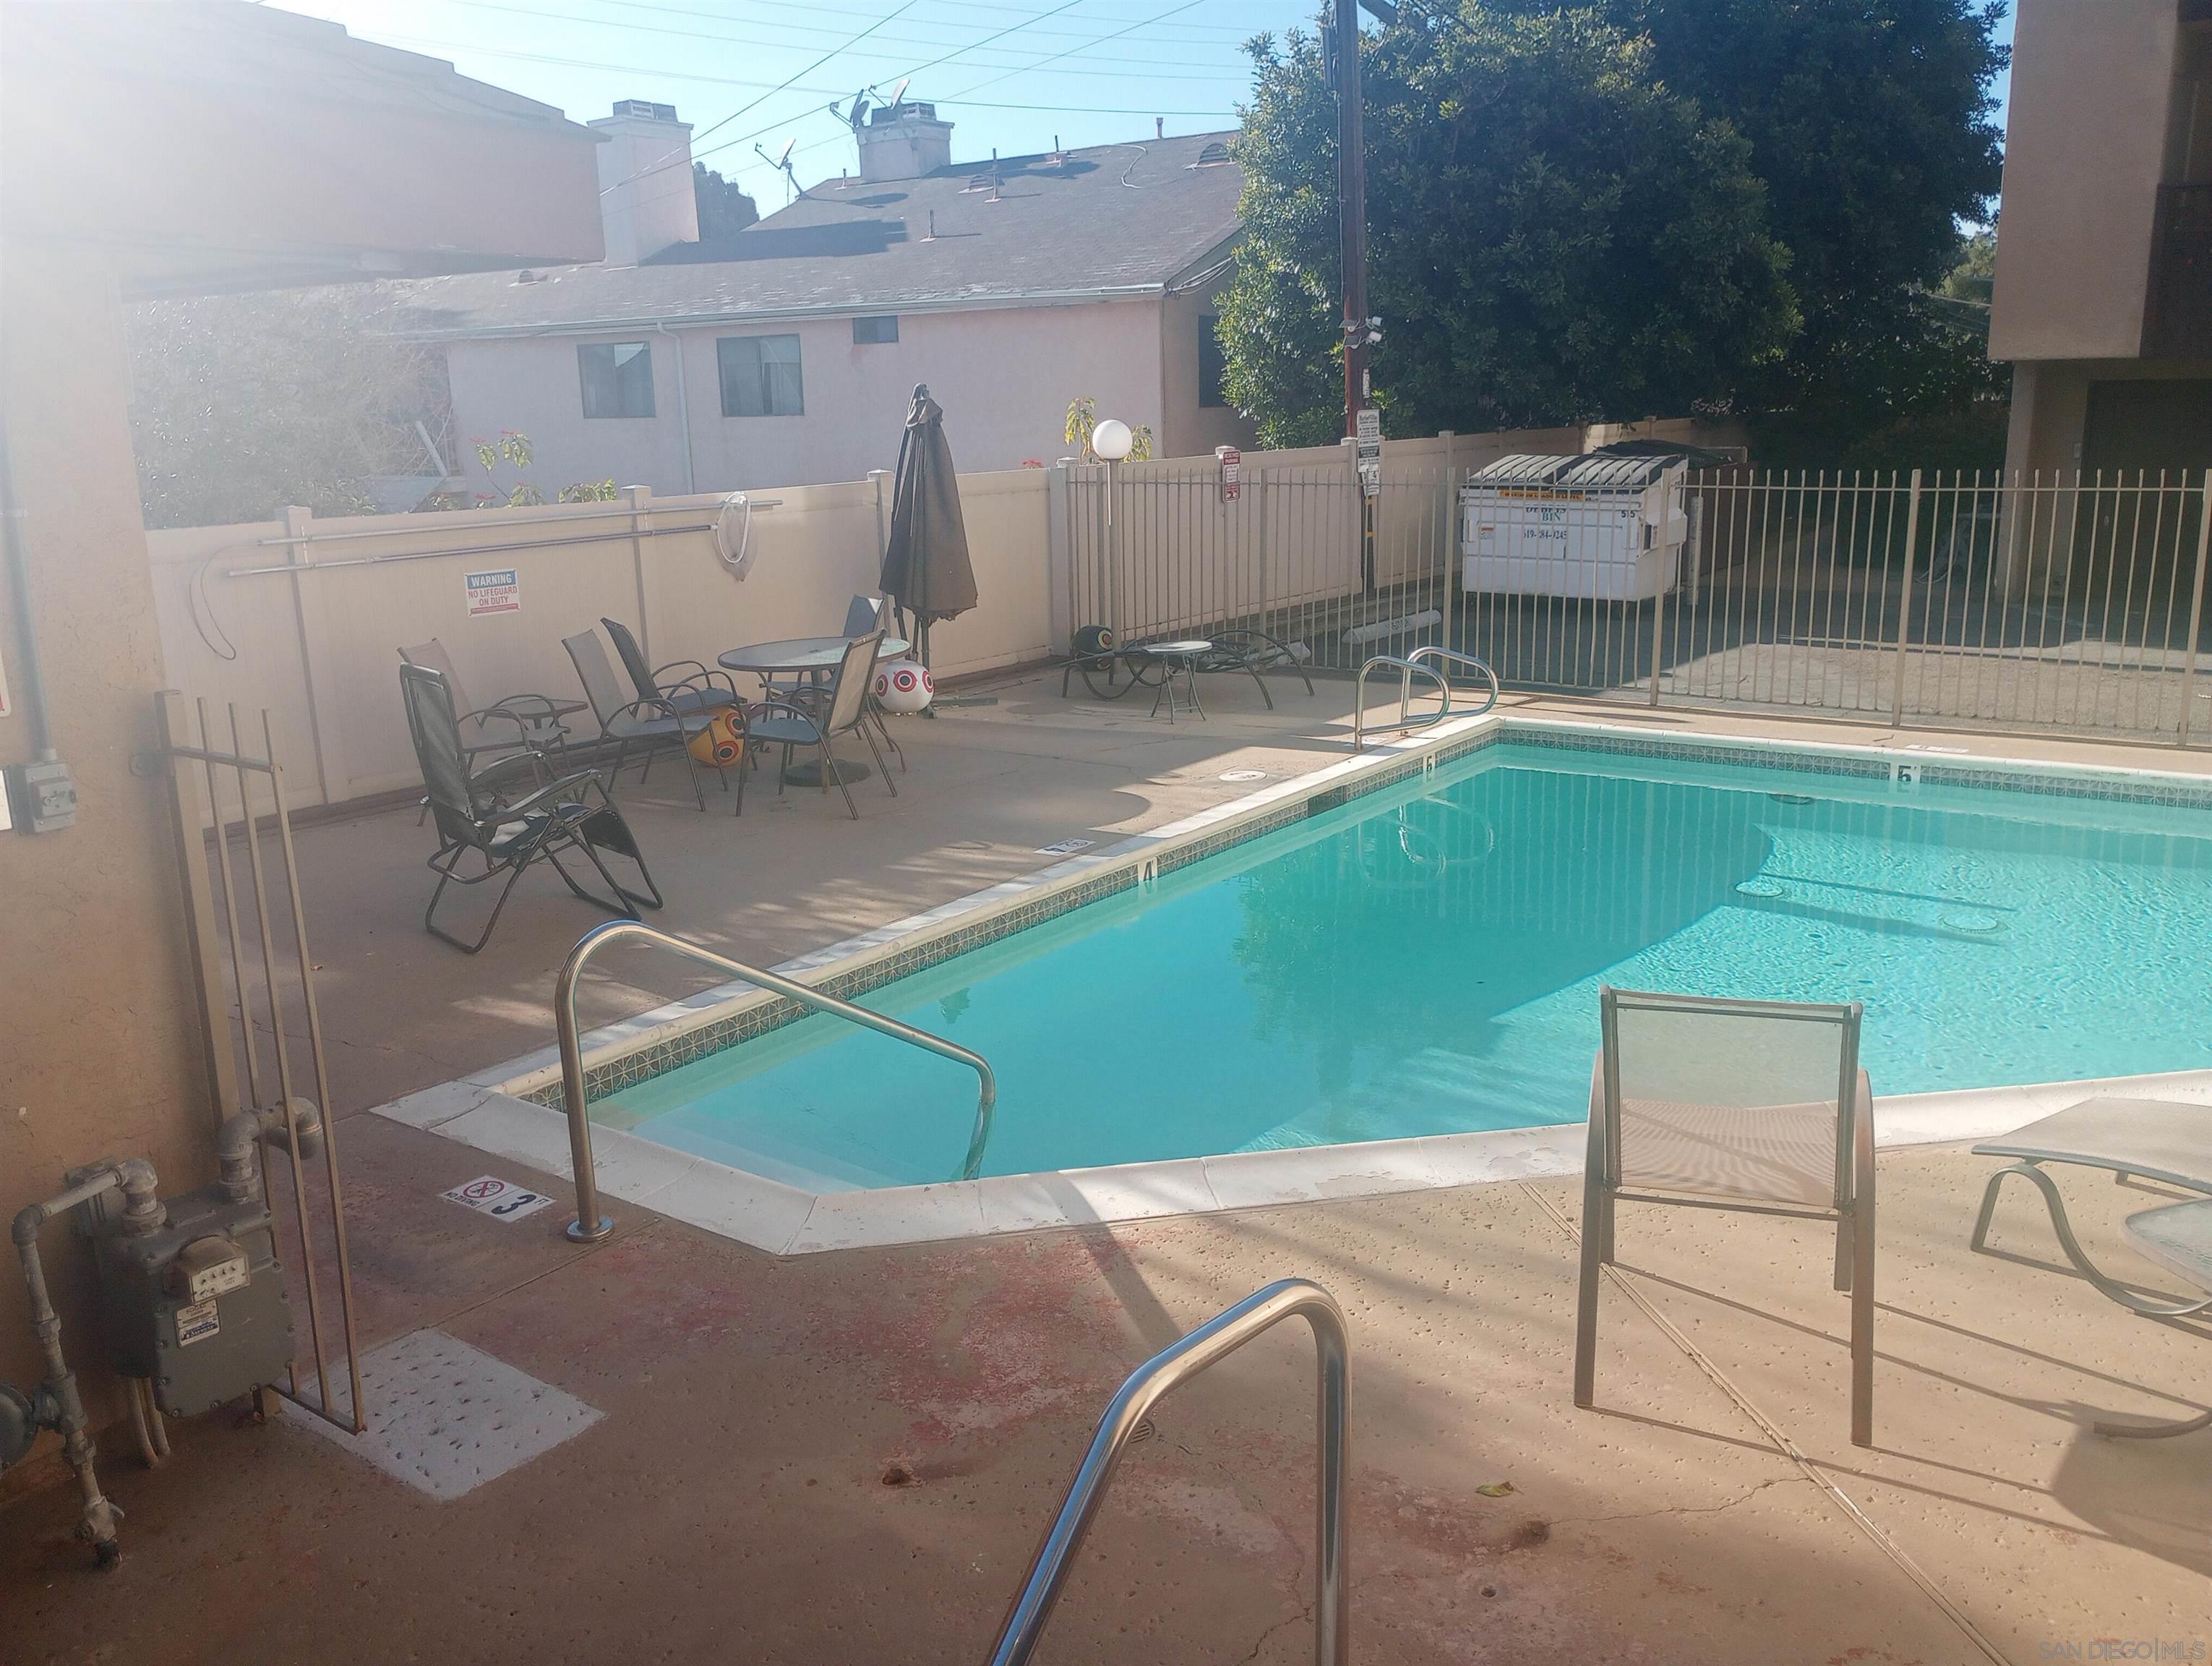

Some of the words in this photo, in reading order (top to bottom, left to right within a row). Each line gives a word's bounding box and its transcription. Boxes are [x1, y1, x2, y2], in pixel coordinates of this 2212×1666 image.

[1542, 512, 1561, 521] BIN
[471, 573, 512, 586] WARNING
[468, 590, 479, 599] NO
[480, 586, 518, 597] LIFEGUARD
[491, 596, 509, 605] DUTY
[455, 1195, 480, 1205] DIVING
[491, 1194, 537, 1214] 3
